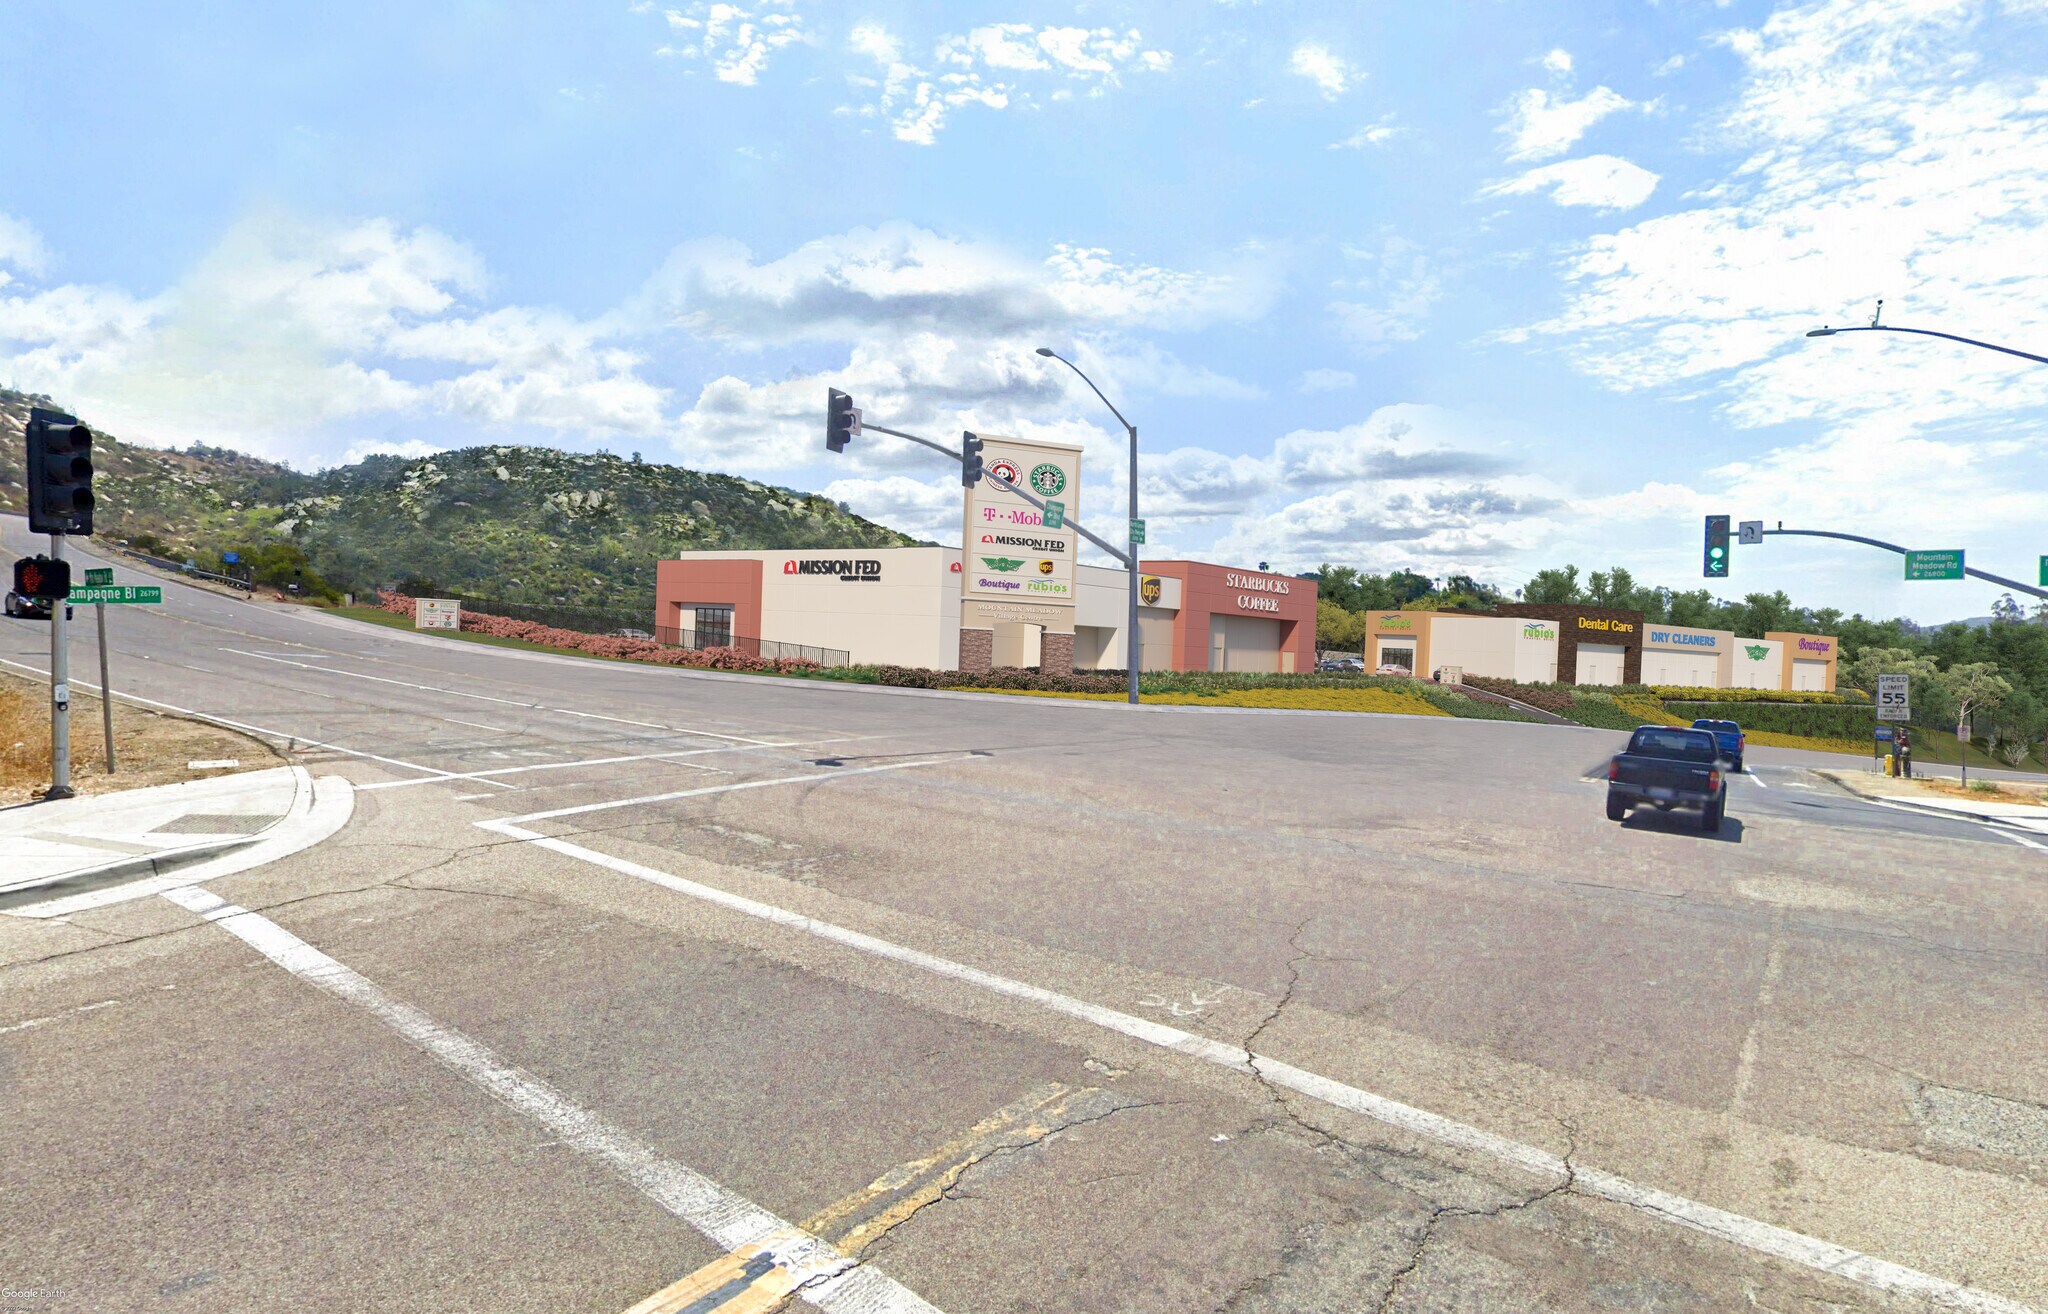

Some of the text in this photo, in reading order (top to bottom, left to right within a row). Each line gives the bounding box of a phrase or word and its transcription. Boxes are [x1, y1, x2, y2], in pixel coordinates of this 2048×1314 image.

[1033, 465, 1064, 481] STARBUCKS
[1035, 485, 1059, 494] COFFEE
[995, 535, 1065, 549] MISSION FED
[1917, 553, 1954, 561] Mountain
[798, 560, 881, 575] MISSION FED
[1040, 563, 1053, 572] ups
[1912, 561, 1958, 570] Meadow Rd
[978, 578, 1020, 591] Boutique
[1027, 581, 1067, 592] rubio's
[1226, 573, 1289, 595] STARBUCKS
[69, 589, 121, 602] ampagne
[1144, 584, 1160, 600] ups
[977, 604, 1063, 615] MOUNTAIN MEADOW
[1237, 594, 1279, 612] COFFEE
[993, 613, 1018, 622] Village
[1578, 617, 1633, 633] Dental Care
[1523, 626, 1555, 639] rubio's
[1651, 631, 1716, 647] DRY CLEANERS
[1798, 637, 1830, 655] Boutique
[1882, 693, 1906, 704] 55
